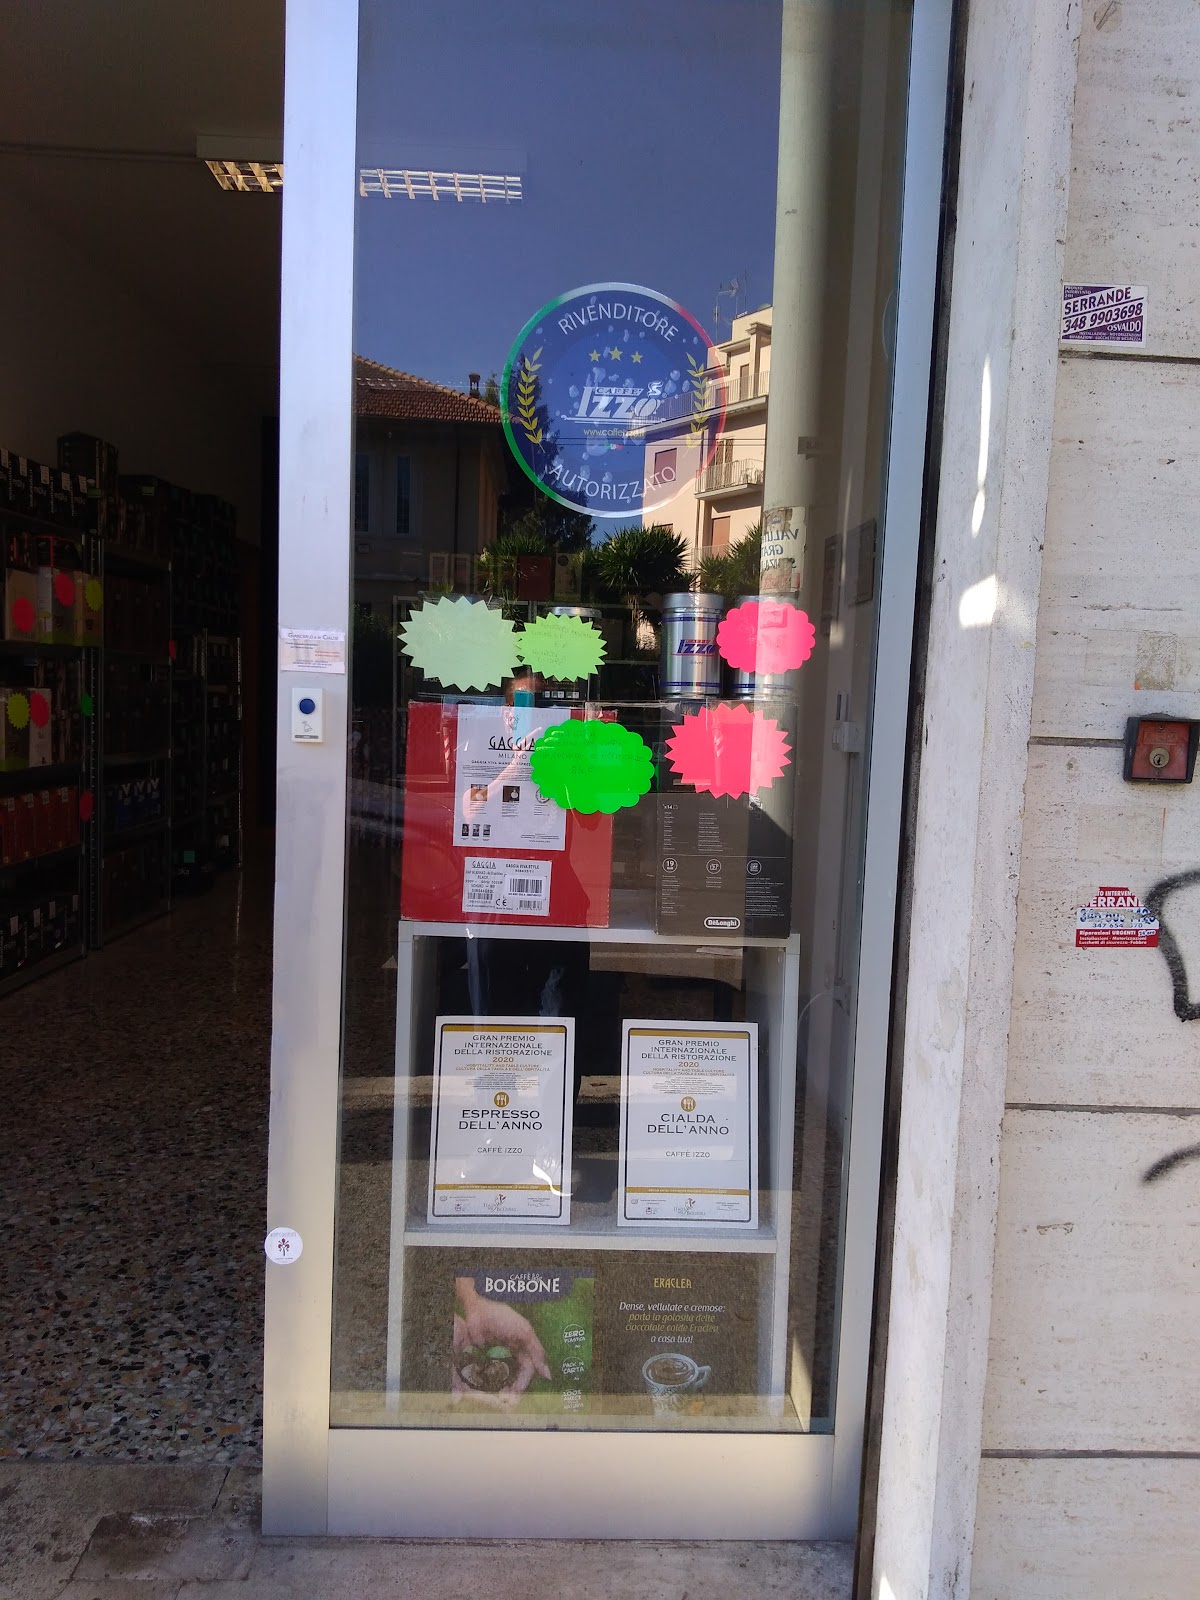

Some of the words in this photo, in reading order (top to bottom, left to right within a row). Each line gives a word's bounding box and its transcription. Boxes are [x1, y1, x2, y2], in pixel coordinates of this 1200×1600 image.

[1065, 287, 1131, 315] SERRANDE
[558, 303, 678, 342] RIVENDITORE
[1063, 315, 1087, 333] 348
[1090, 303, 1143, 327] 9903698
[1107, 320, 1141, 332] OSVALDO
[549, 464, 676, 500] AUTORIZZATO
[488, 735, 535, 751] GAGGIA
[472, 861, 496, 869] GAGGIA
[1082, 897, 1145, 907] ERRAN
[651, 1046, 727, 1055] INTERNAZIONALE
[671, 1053, 736, 1061] RISTORAZIONE
[462, 1109, 540, 1119] ESPRESSO
[660, 1113, 716, 1123] CIALDA
[665, 1149, 690, 1157] CAFFÈ
[485, 1277, 560, 1293] BORBONE
[654, 1278, 692, 1289] ERACLEA
[619, 1301, 646, 1312] Dense,
[647, 1303, 683, 1312] vellutate
[690, 1305, 726, 1313] cremose:
[629, 1313, 651, 1322] porta
[625, 1323, 665, 1332] cioccolate
[666, 1324, 688, 1332] calde
[689, 1324, 719, 1332] Eraclea
[564, 1330, 585, 1338] ZERO
[677, 1335, 694, 1343] tua!
[563, 1366, 585, 1374] CARTA
